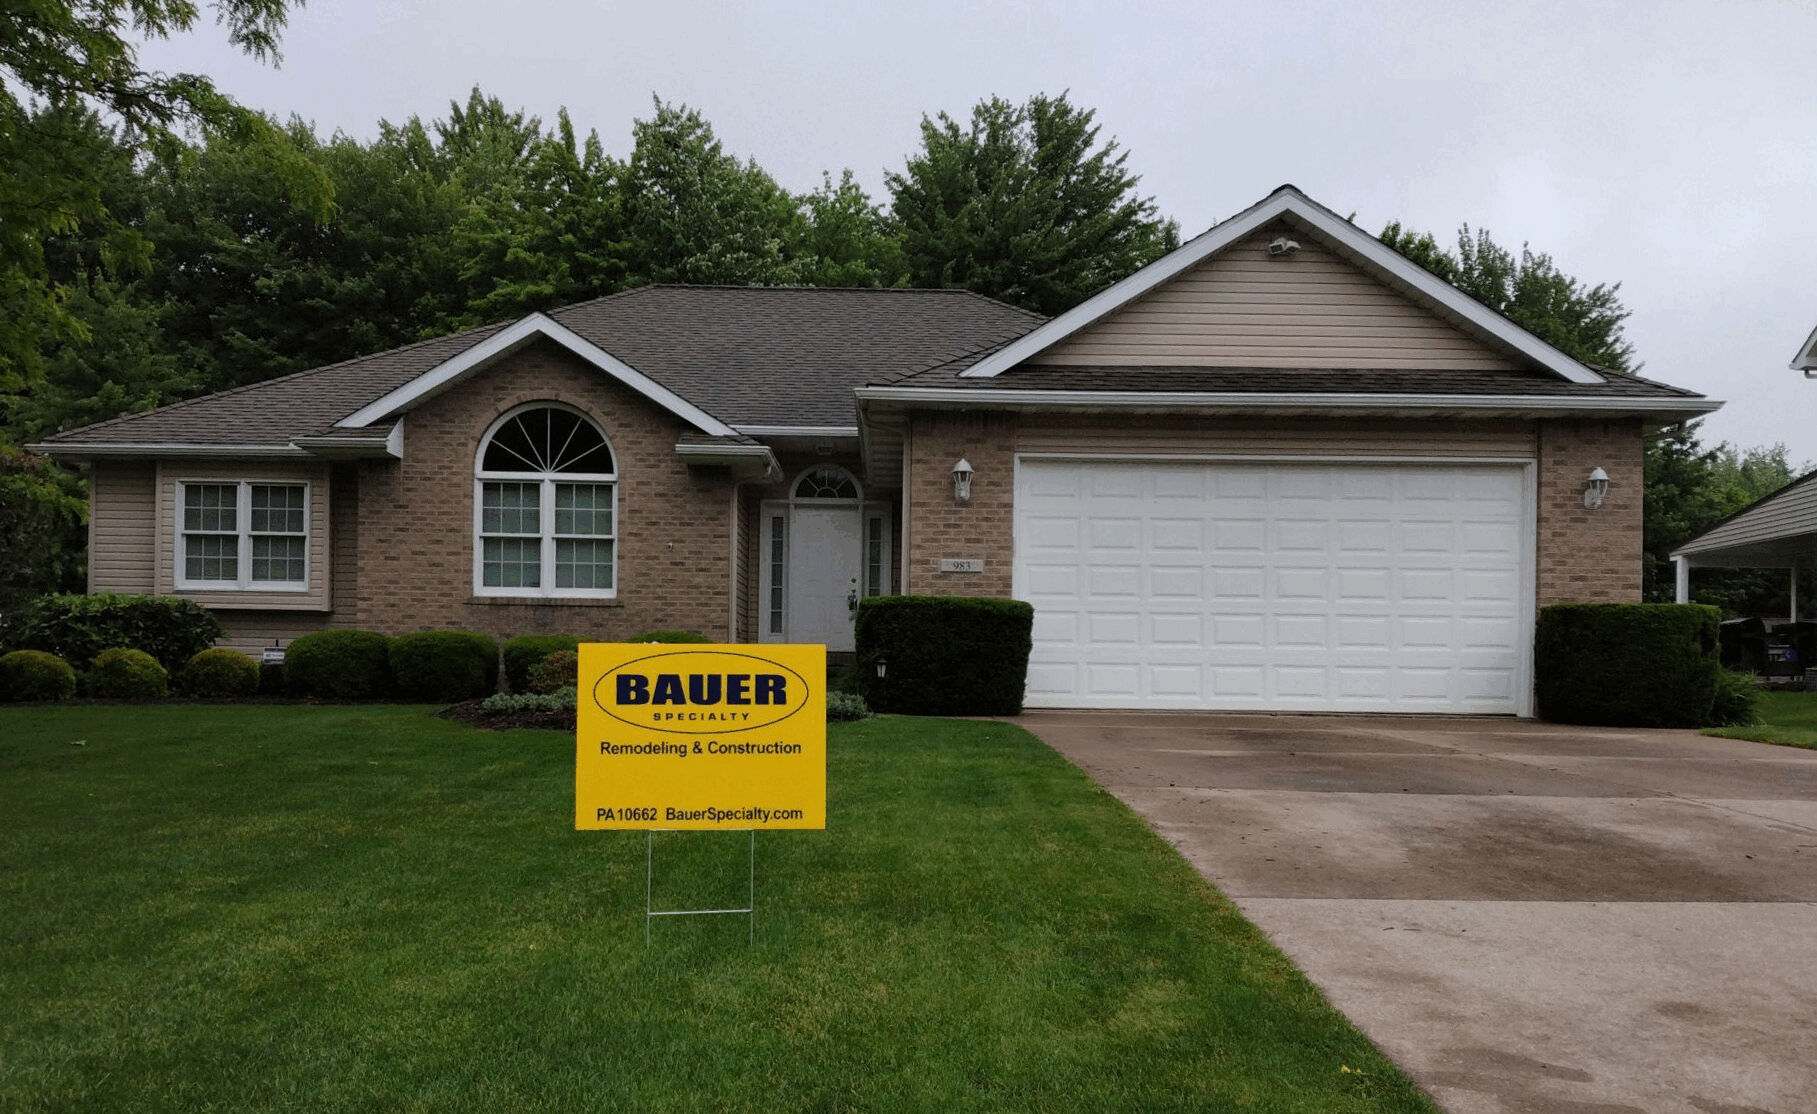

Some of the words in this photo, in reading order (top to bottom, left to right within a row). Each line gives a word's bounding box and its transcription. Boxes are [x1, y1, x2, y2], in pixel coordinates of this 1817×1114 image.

[952, 560, 971, 571] 983
[616, 674, 787, 706] BAUER
[652, 712, 750, 722] SPECIALTY
[600, 741, 688, 758] Remodeling
[692, 741, 704, 755] &
[707, 741, 802, 755] Construction
[665, 807, 803, 824] BauerSpecialty.com
